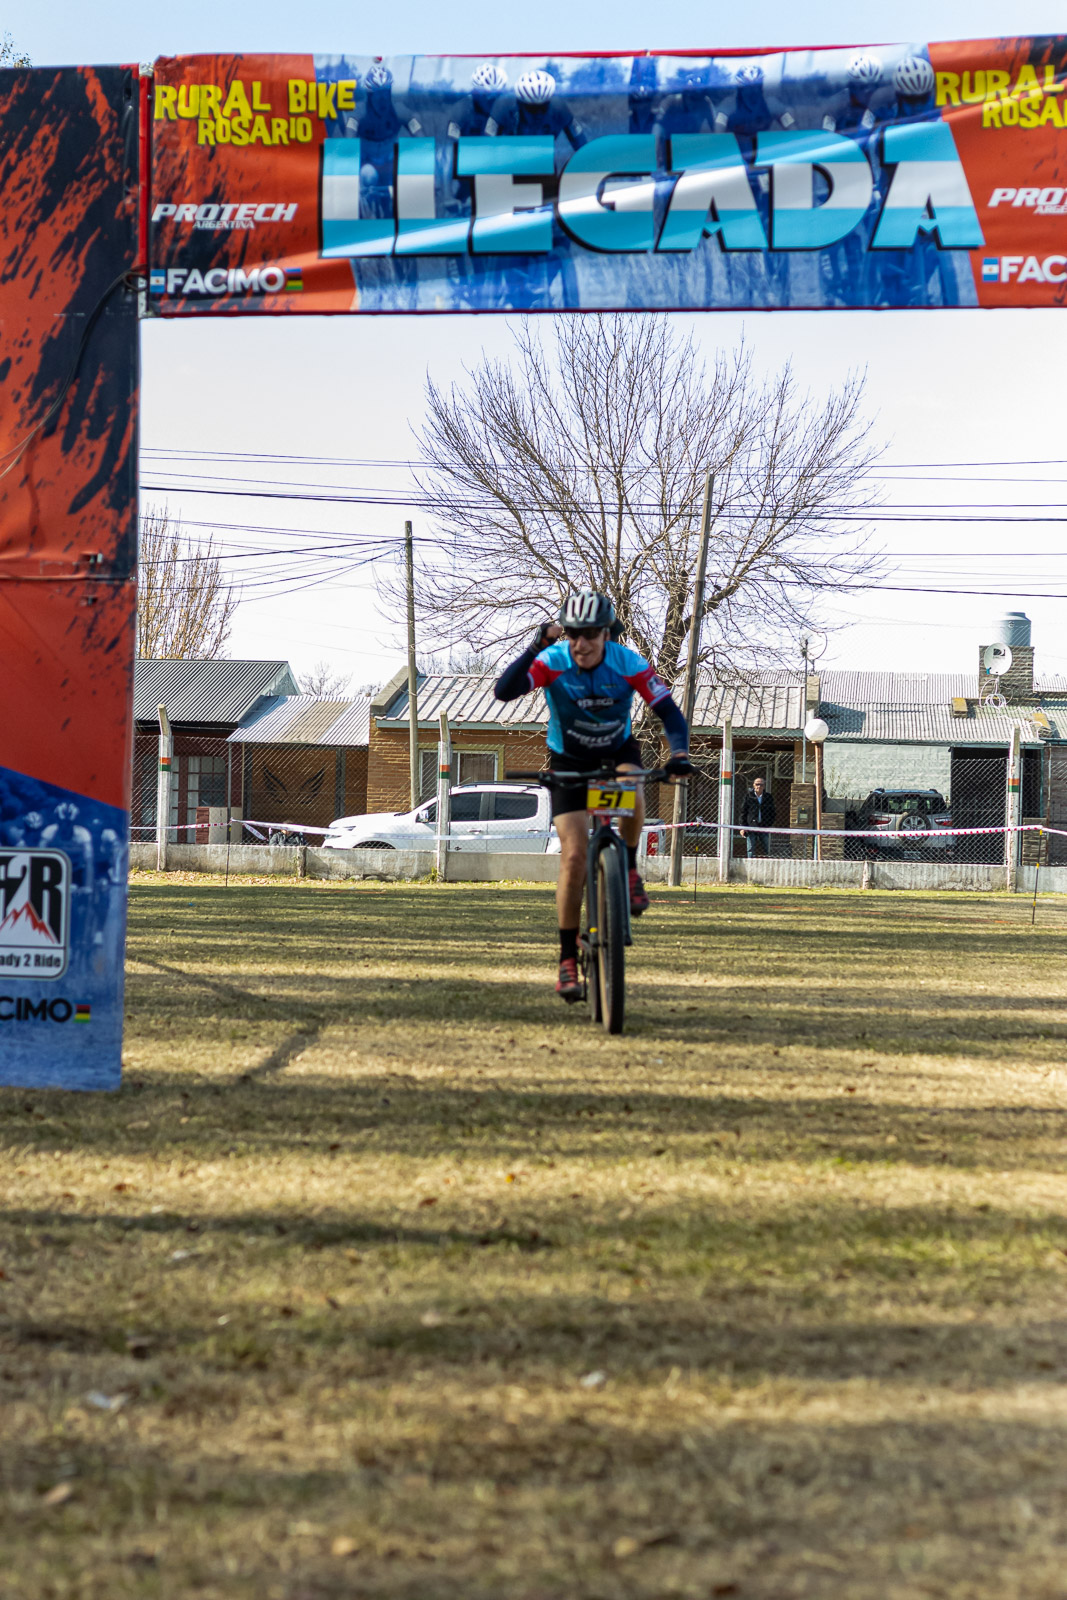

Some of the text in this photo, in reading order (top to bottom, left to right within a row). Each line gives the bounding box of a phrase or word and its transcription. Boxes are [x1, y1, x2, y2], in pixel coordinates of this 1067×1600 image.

[936, 64, 1065, 106] RURAL
[154, 79, 356, 120] RURAL BIKE
[982, 95, 1067, 129] ROSA
[197, 115, 312, 145] ROSARIO
[319, 121, 986, 259] LLEGADA
[151, 203, 298, 221] PROTECH
[192, 220, 255, 229] ARGENTINA
[166, 266, 285, 293] FACIMO
[598, 790, 623, 807] 51
[24, 953, 31, 967] 2
[34, 954, 61, 968] Ride
